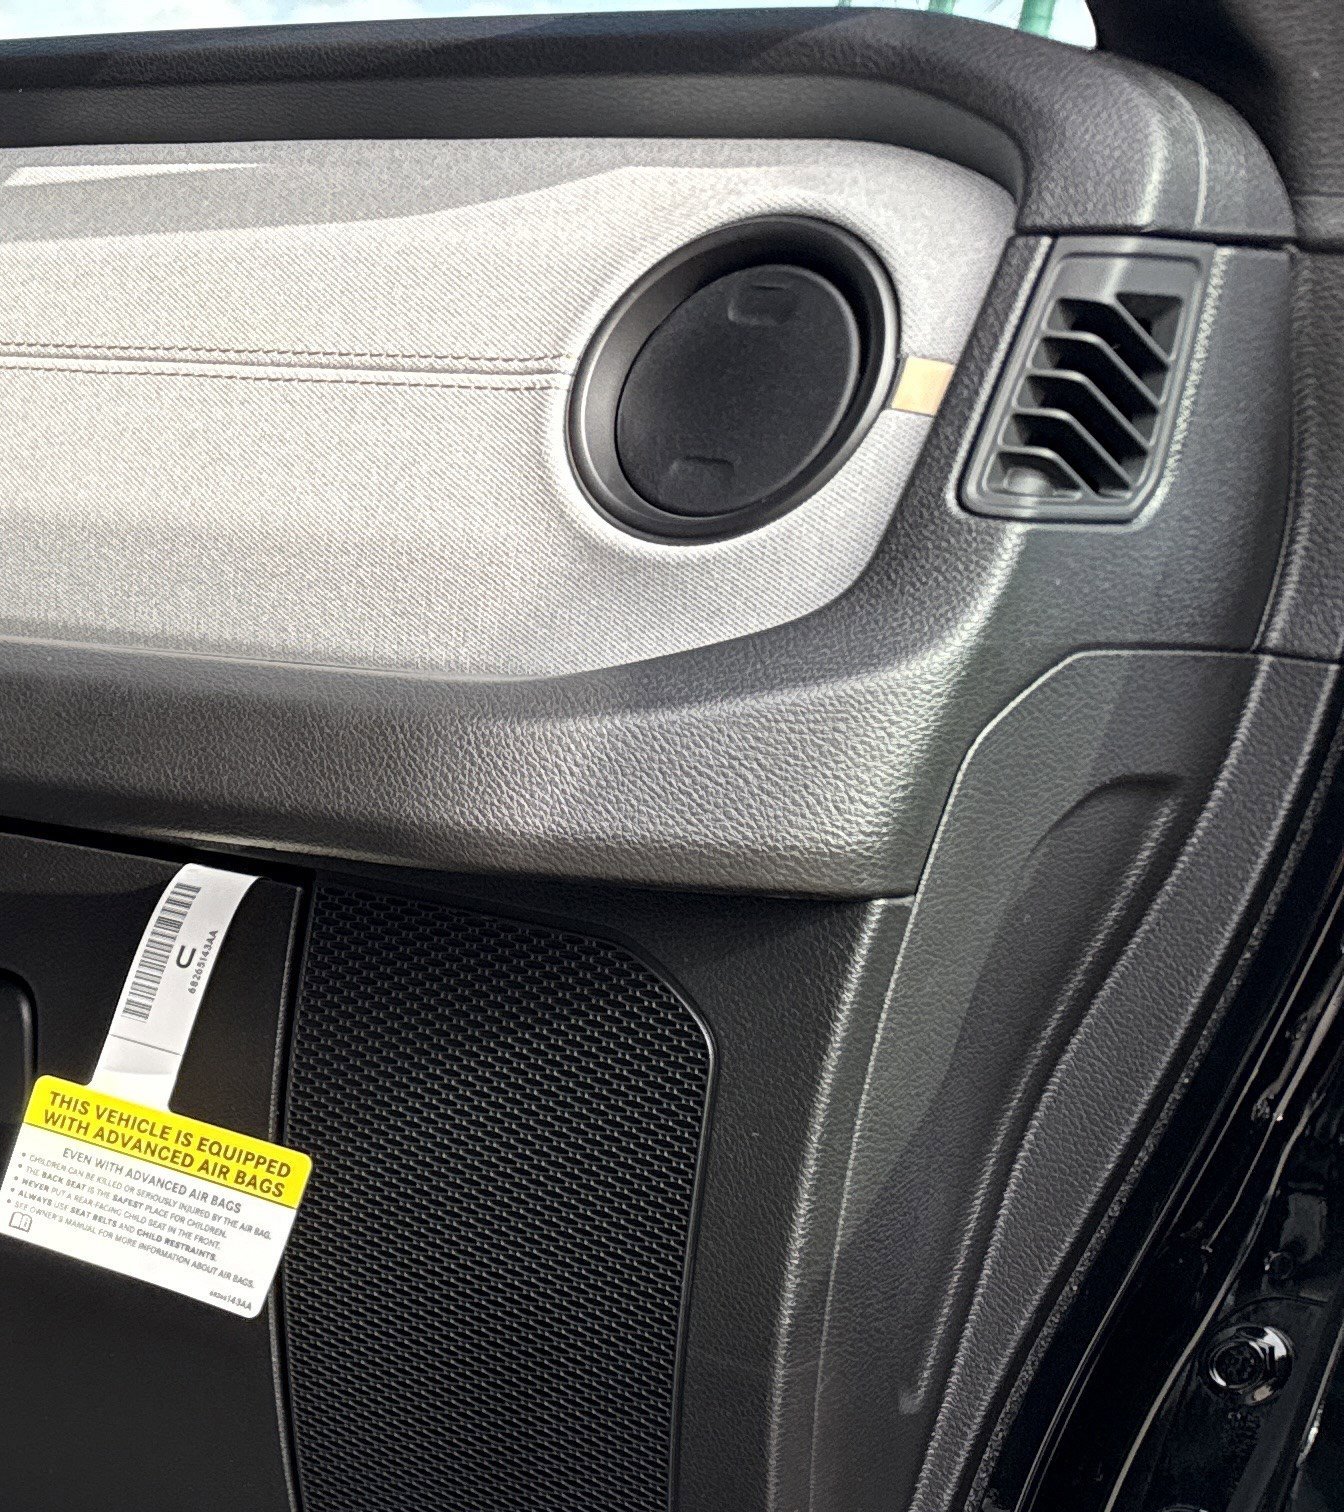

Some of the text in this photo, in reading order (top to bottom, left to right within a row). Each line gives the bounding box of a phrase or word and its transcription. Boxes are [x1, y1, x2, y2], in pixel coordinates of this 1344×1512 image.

[175, 945, 197, 969] U
[44, 1109, 285, 1198] WITH ADVANCED AIR BAGS
[50, 1090, 291, 1178] THIS VEHICLE IS EQUIPPED
[62, 1147, 242, 1214] EVEN WITH ADVANCED AIR BAGS
